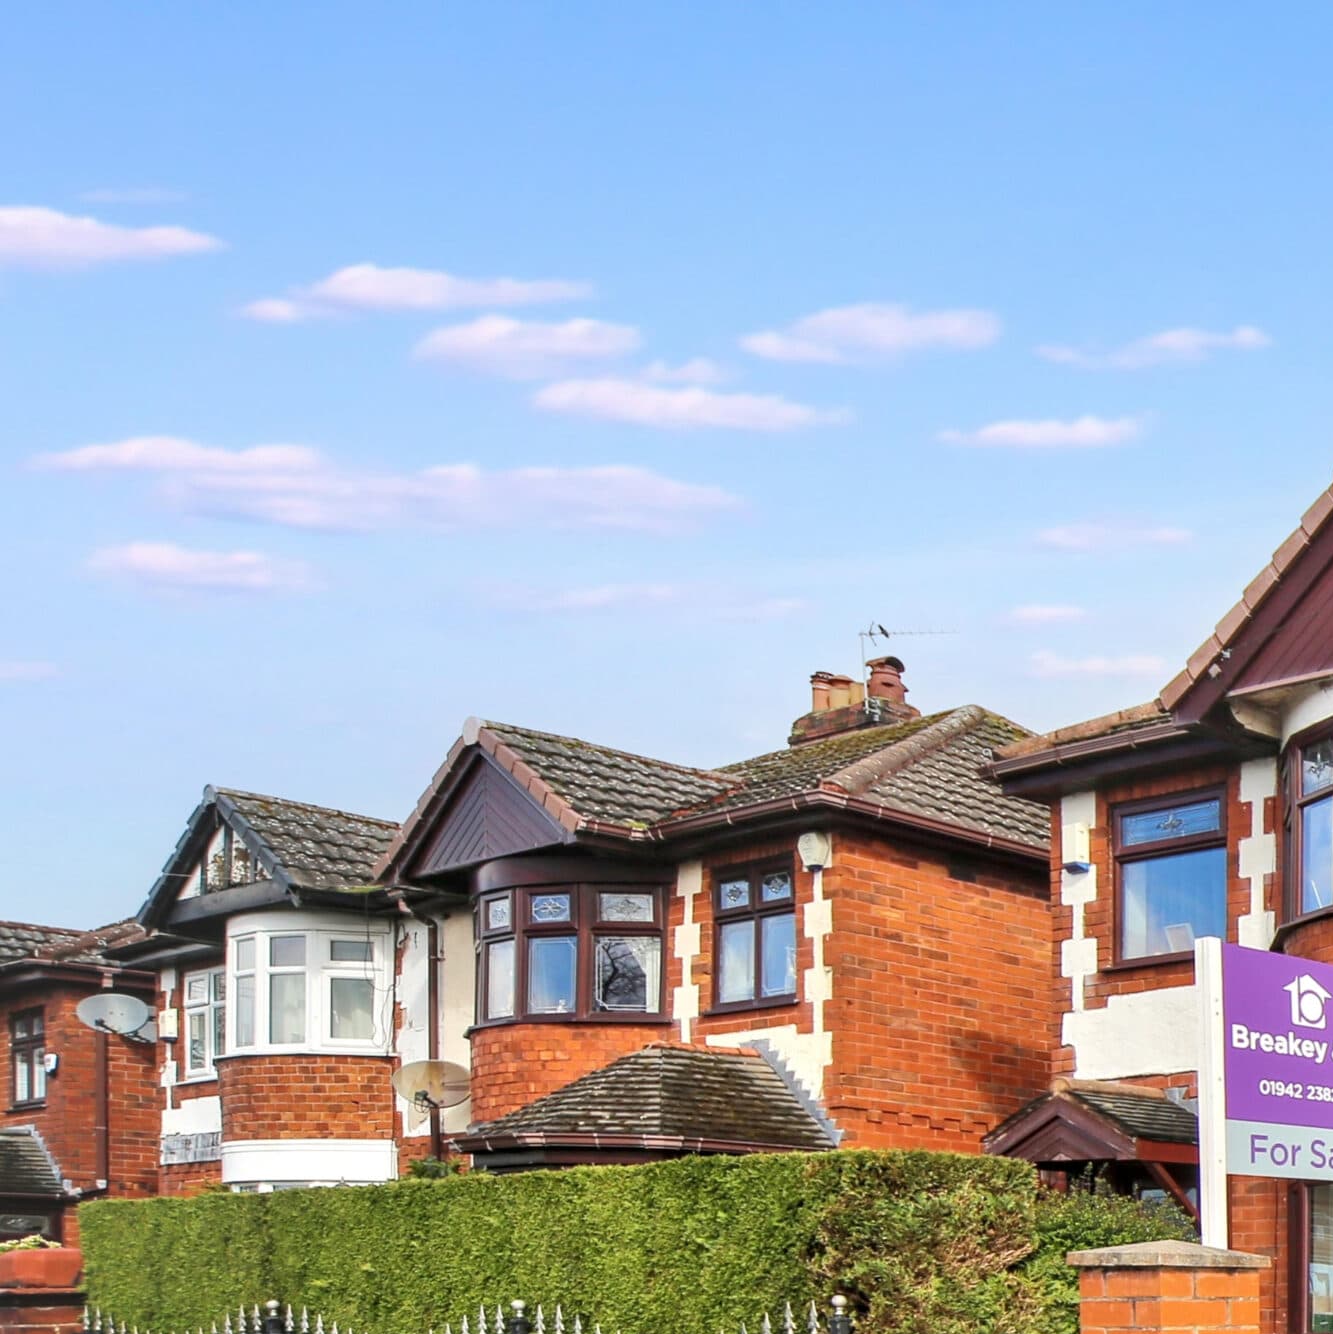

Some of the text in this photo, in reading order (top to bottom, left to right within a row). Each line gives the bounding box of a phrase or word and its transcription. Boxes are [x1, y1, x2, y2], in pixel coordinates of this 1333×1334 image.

[1231, 1023, 1328, 1064] Breakey
[1258, 1079, 1304, 1099] 01942
[1250, 1134, 1302, 1167] For
